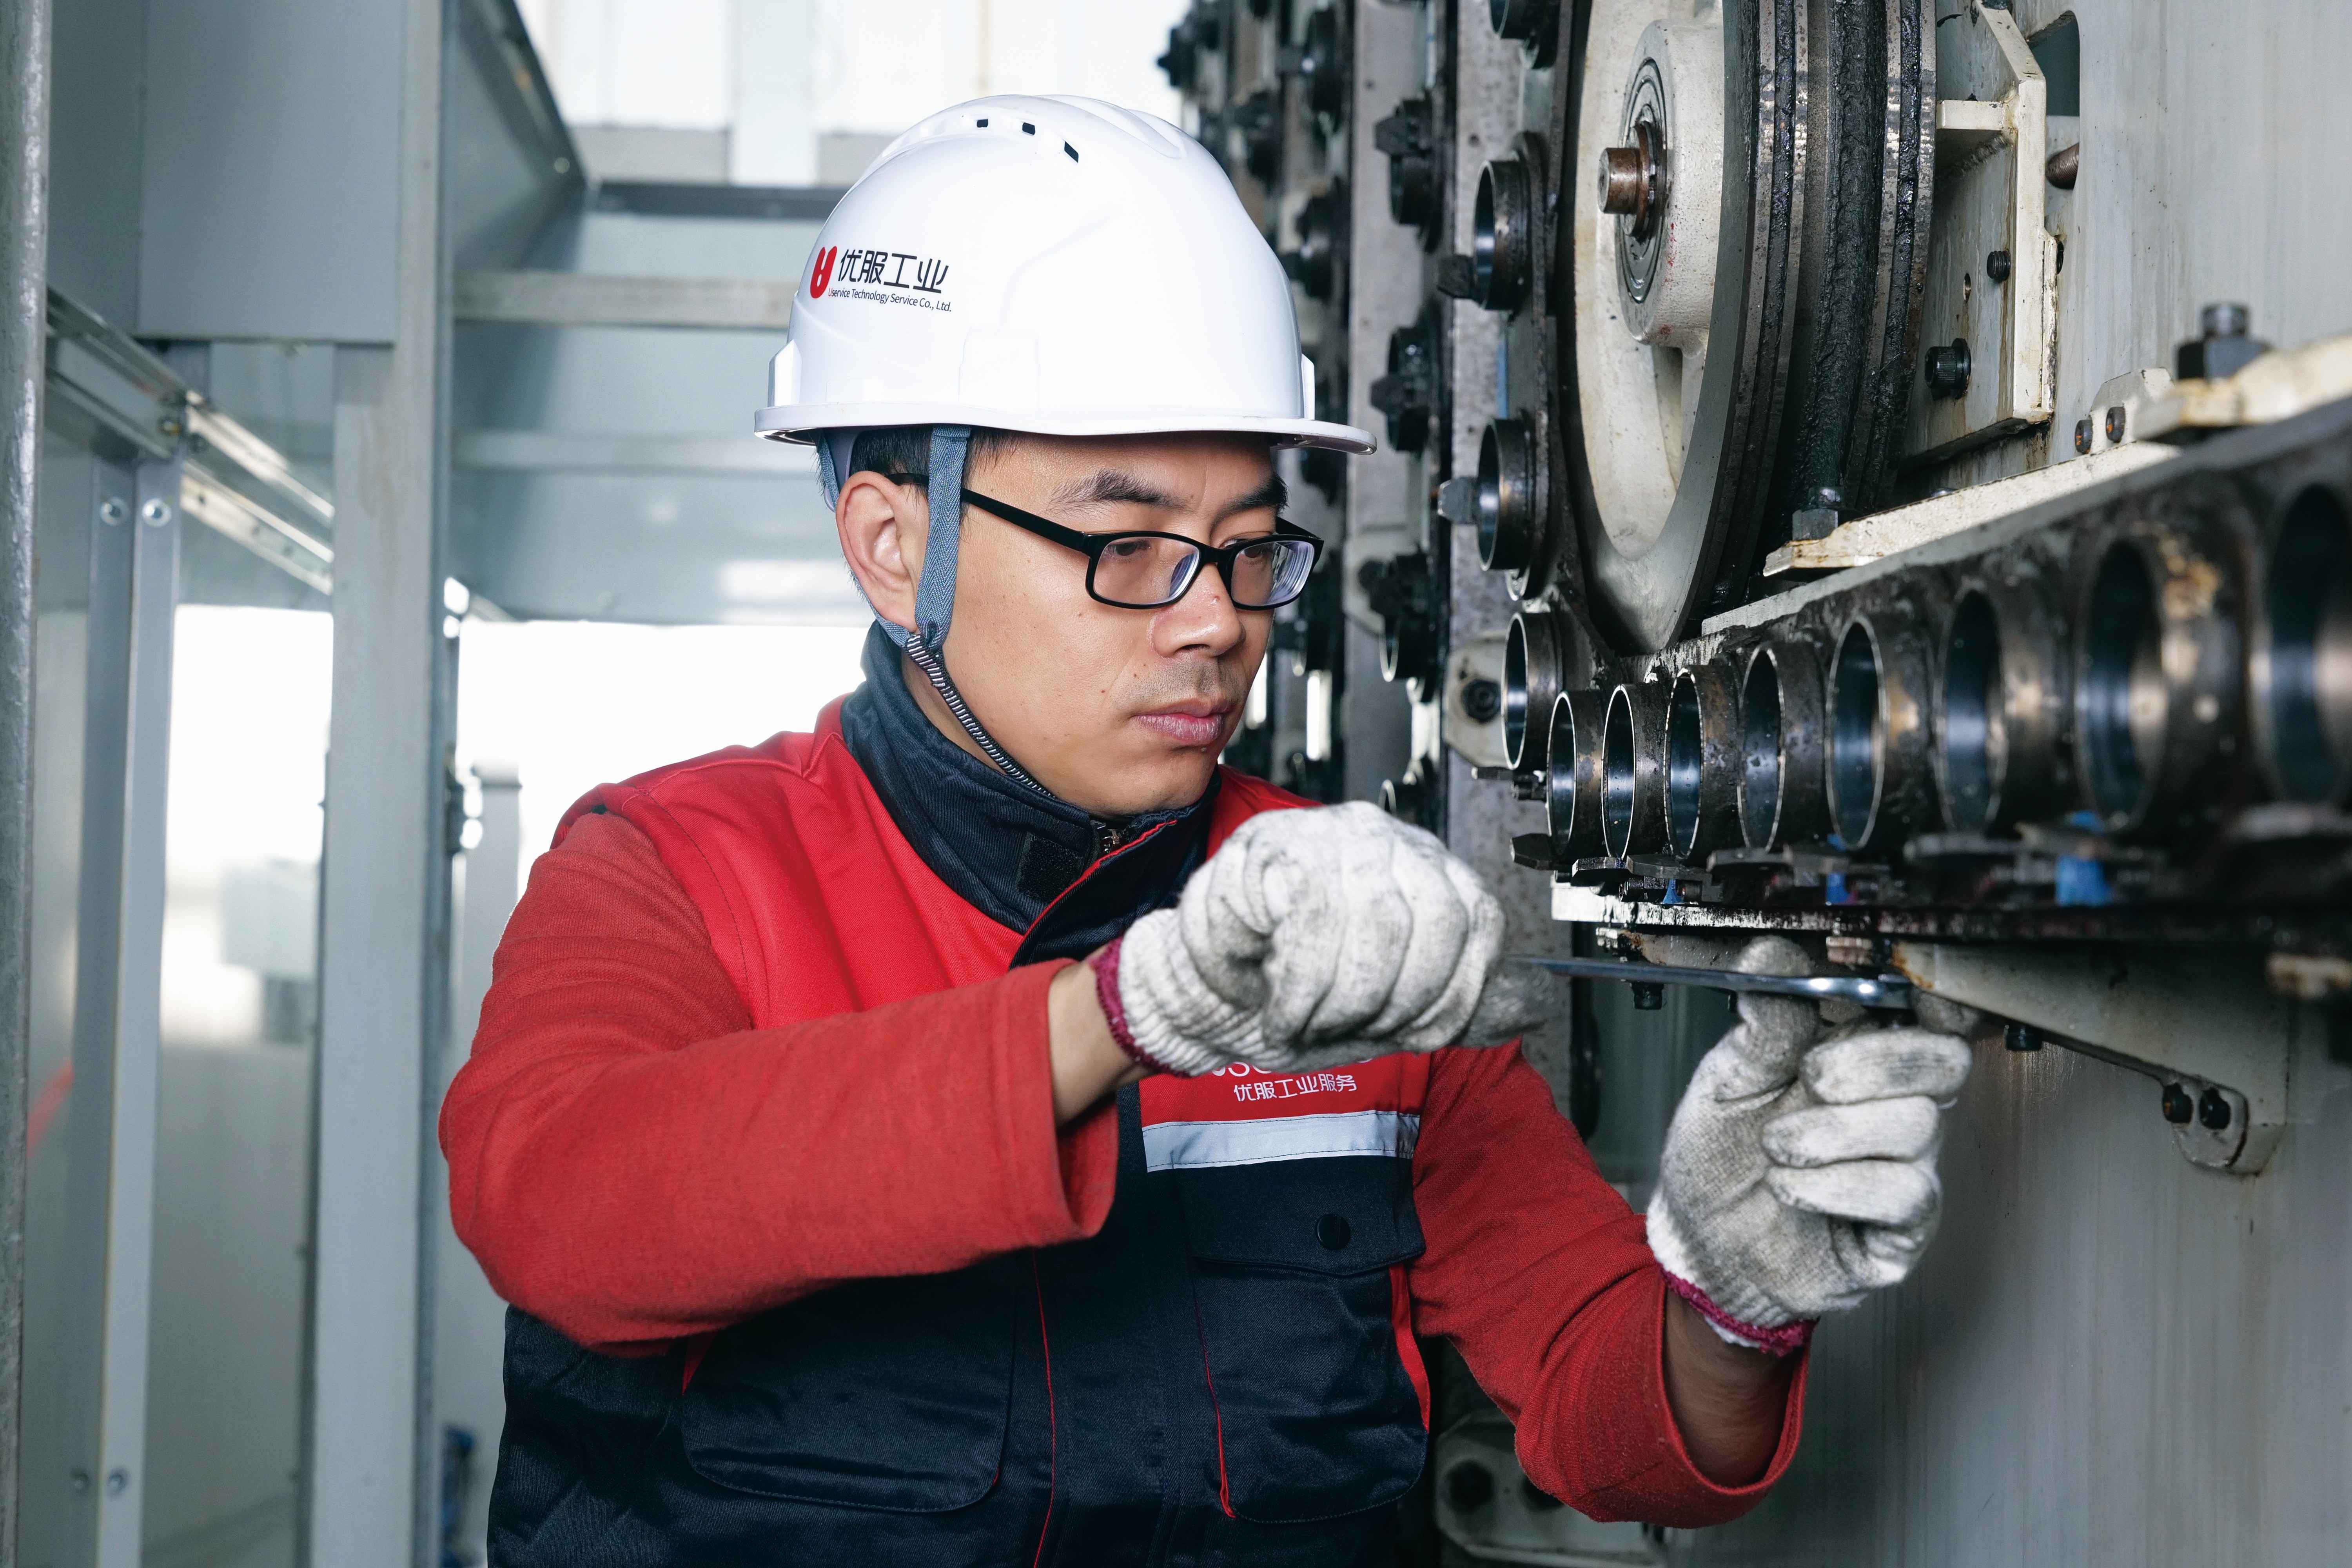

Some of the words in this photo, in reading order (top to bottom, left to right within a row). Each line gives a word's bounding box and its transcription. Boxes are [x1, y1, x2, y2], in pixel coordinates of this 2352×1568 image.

[838, 249, 949, 294] 优服工业
[828, 288, 850, 298] Uservice
[852, 289, 889, 304] Technology
[890, 294, 918, 306] Service
[919, 298, 934, 310] Co.,
[936, 301, 951, 312] Ltd.
[1233, 1073, 1357, 1102] 优服工业服务
